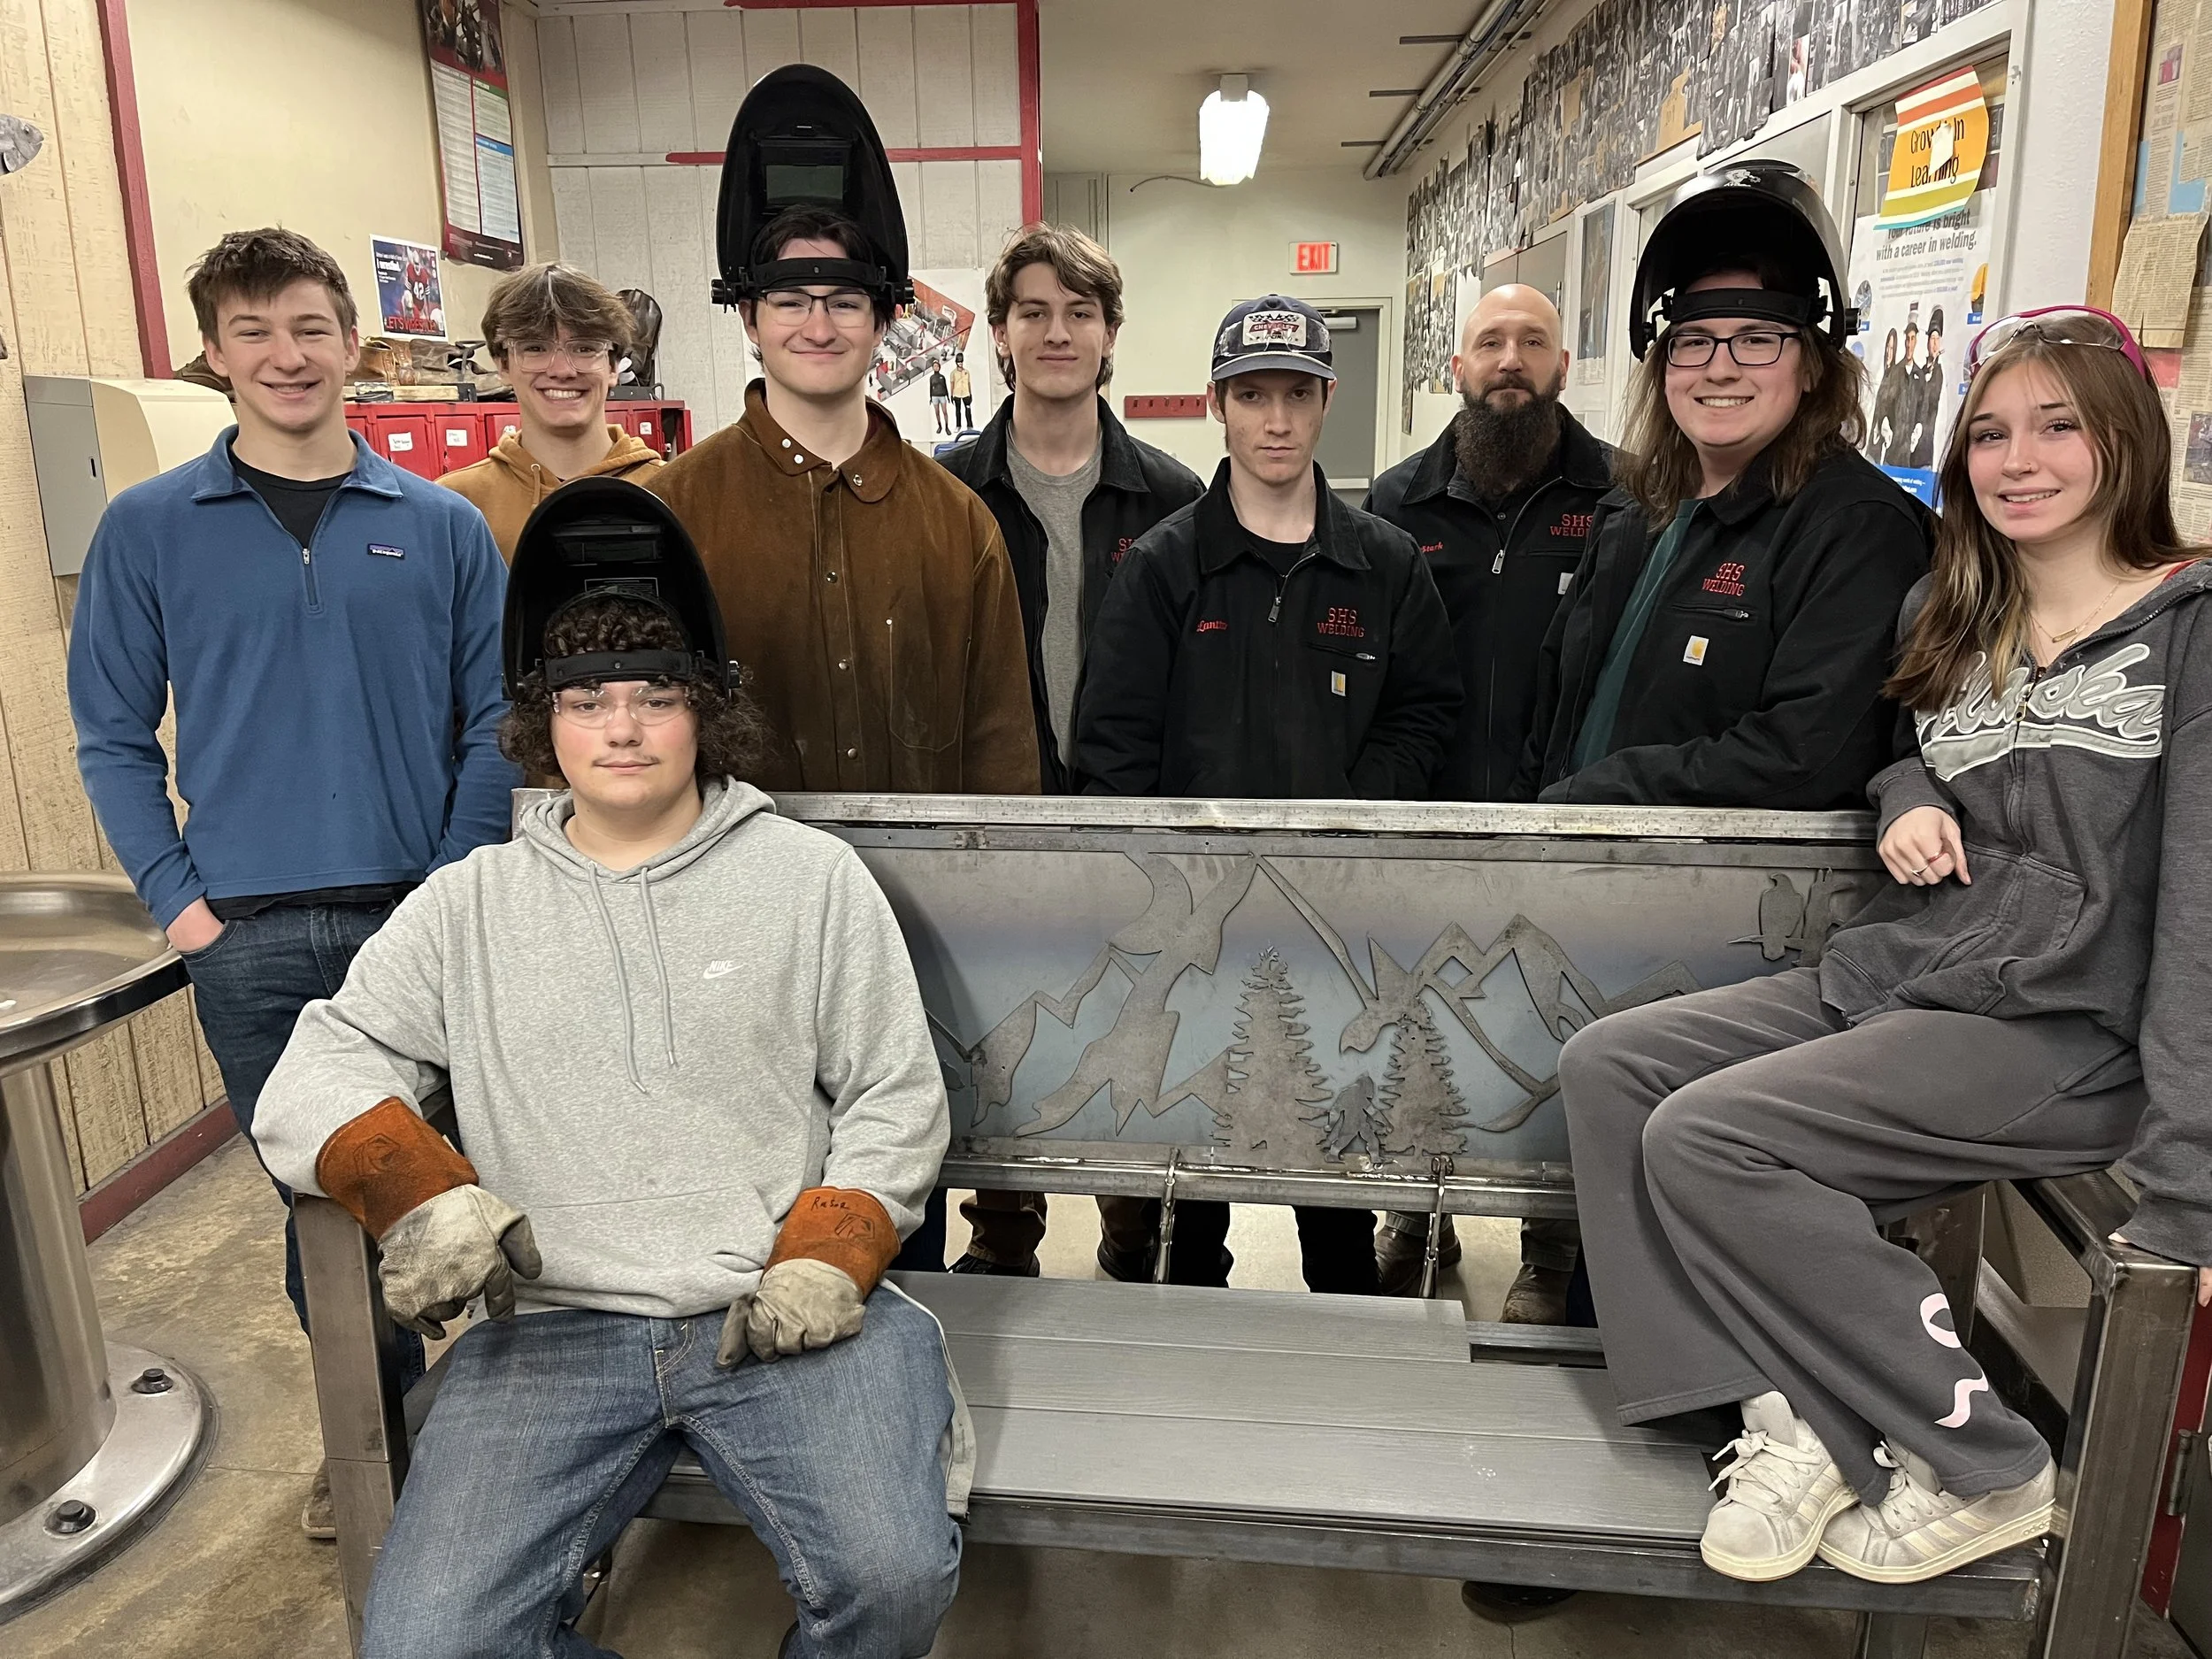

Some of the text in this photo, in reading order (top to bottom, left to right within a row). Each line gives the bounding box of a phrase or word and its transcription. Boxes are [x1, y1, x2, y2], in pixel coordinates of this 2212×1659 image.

[1911, 120, 1947, 154] Grow
[1954, 117, 1964, 142] In
[1911, 155, 1959, 188] Leaning
[1932, 216, 1941, 231] is
[1943, 208, 1970, 231] bright
[1876, 230, 1977, 261] with a career in welding.
[1298, 243, 1331, 271] EXIT
[413, 281, 425, 301] 42
[1561, 513, 1594, 527] SHS
[1550, 526, 1590, 537] WELD
[1716, 563, 1745, 581] SHS
[1701, 578, 1745, 596] WELDING
[1328, 607, 1357, 625] SHS
[1317, 622, 1365, 638] WELDING
[709, 960, 734, 972] NIKE
[2024, 1520, 2051, 1535] adida
